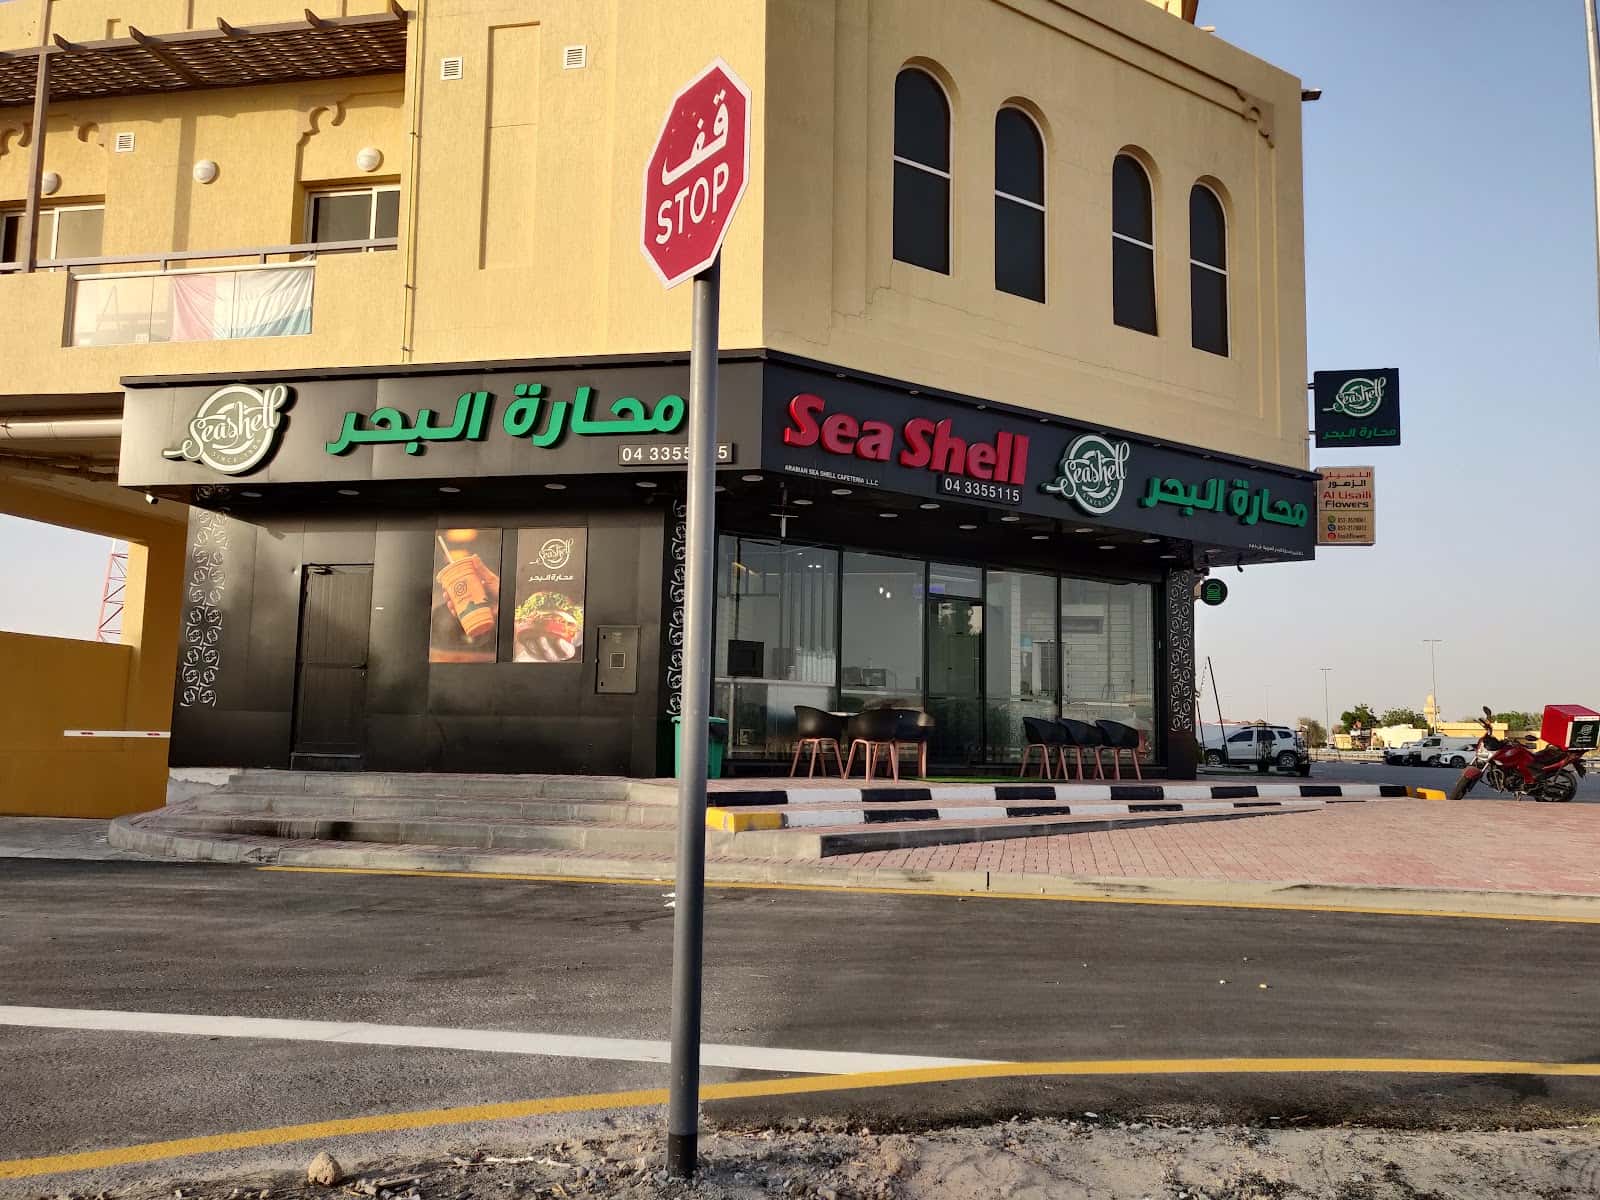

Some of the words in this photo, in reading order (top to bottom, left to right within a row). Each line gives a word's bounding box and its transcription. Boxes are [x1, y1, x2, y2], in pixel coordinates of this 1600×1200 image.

[661, 88, 729, 186] قف
[655, 161, 729, 245] STOP
[163, 384, 288, 460] Seashell
[326, 391, 490, 454] البحر
[502, 383, 687, 447] محارة
[784, 392, 895, 461] Sea
[900, 417, 1030, 486] Shell
[1322, 427, 1356, 439] البحر
[1360, 426, 1397, 438] محارة
[622, 447, 643, 462] 04
[649, 445, 728, 461] 33555
[808, 468, 820, 476] SEA
[820, 470, 836, 479] SHELL
[1045, 441, 1130, 498] Seashell
[944, 477, 961, 493] 04
[964, 481, 1020, 502] 3355115
[1142, 476, 1226, 517] البحر
[1231, 478, 1309, 528] محارة
[1325, 500, 1369, 509] Flowers
